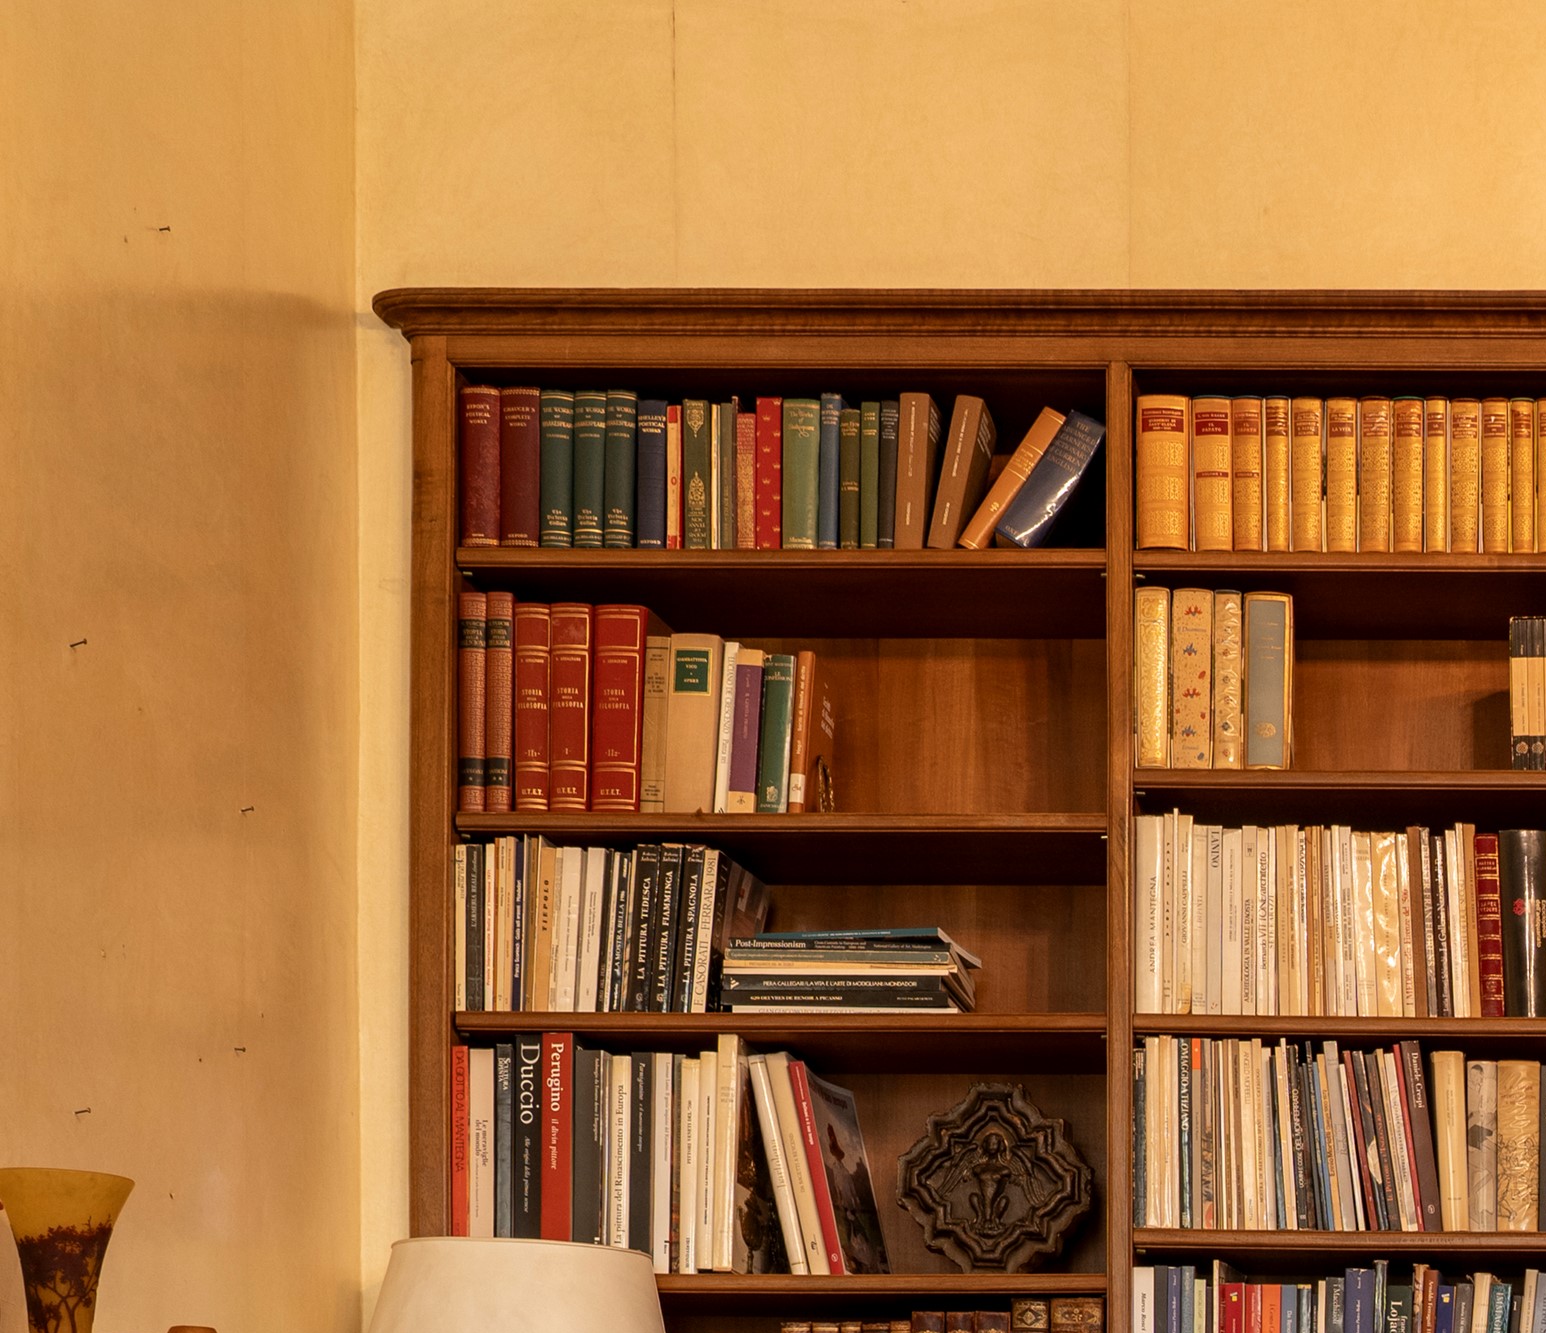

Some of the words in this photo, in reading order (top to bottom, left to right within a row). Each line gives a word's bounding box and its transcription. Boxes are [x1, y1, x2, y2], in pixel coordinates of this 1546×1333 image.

[1211, 831, 1219, 867] LANINO
[707, 857, 715, 876] 1981
[641, 877, 650, 919] TEDESCA
[662, 871, 673, 926] FIAMMINGA
[688, 874, 698, 922] SPAGNOLA
[703, 881, 713, 930] FERRARA
[638, 924, 648, 962] PITTURA
[659, 931, 669, 970] PITTURA
[684, 927, 693, 966] PITTURA
[736, 939, 806, 949] Post-Impressionism
[637, 967, 645, 979] LA
[657, 975, 665, 987] LA
[682, 971, 690, 983] LA
[696, 941, 708, 995] CASORATI
[550, 1043, 564, 1111] Perugino
[1412, 1052, 1420, 1084] Daniele
[520, 1043, 540, 1124] Duccio
[1414, 1086, 1423, 1108] Crespi
[615, 1085, 625, 1110] Europa
[481, 1120, 488, 1128] Le
[616, 1113, 624, 1125] in
[550, 1128, 559, 1146] divin
[550, 1149, 559, 1170] pittore
[615, 1129, 625, 1185] Rinascimento
[615, 1188, 624, 1202] del
[613, 1204, 624, 1231] pittura
[615, 1234, 624, 1244] La
